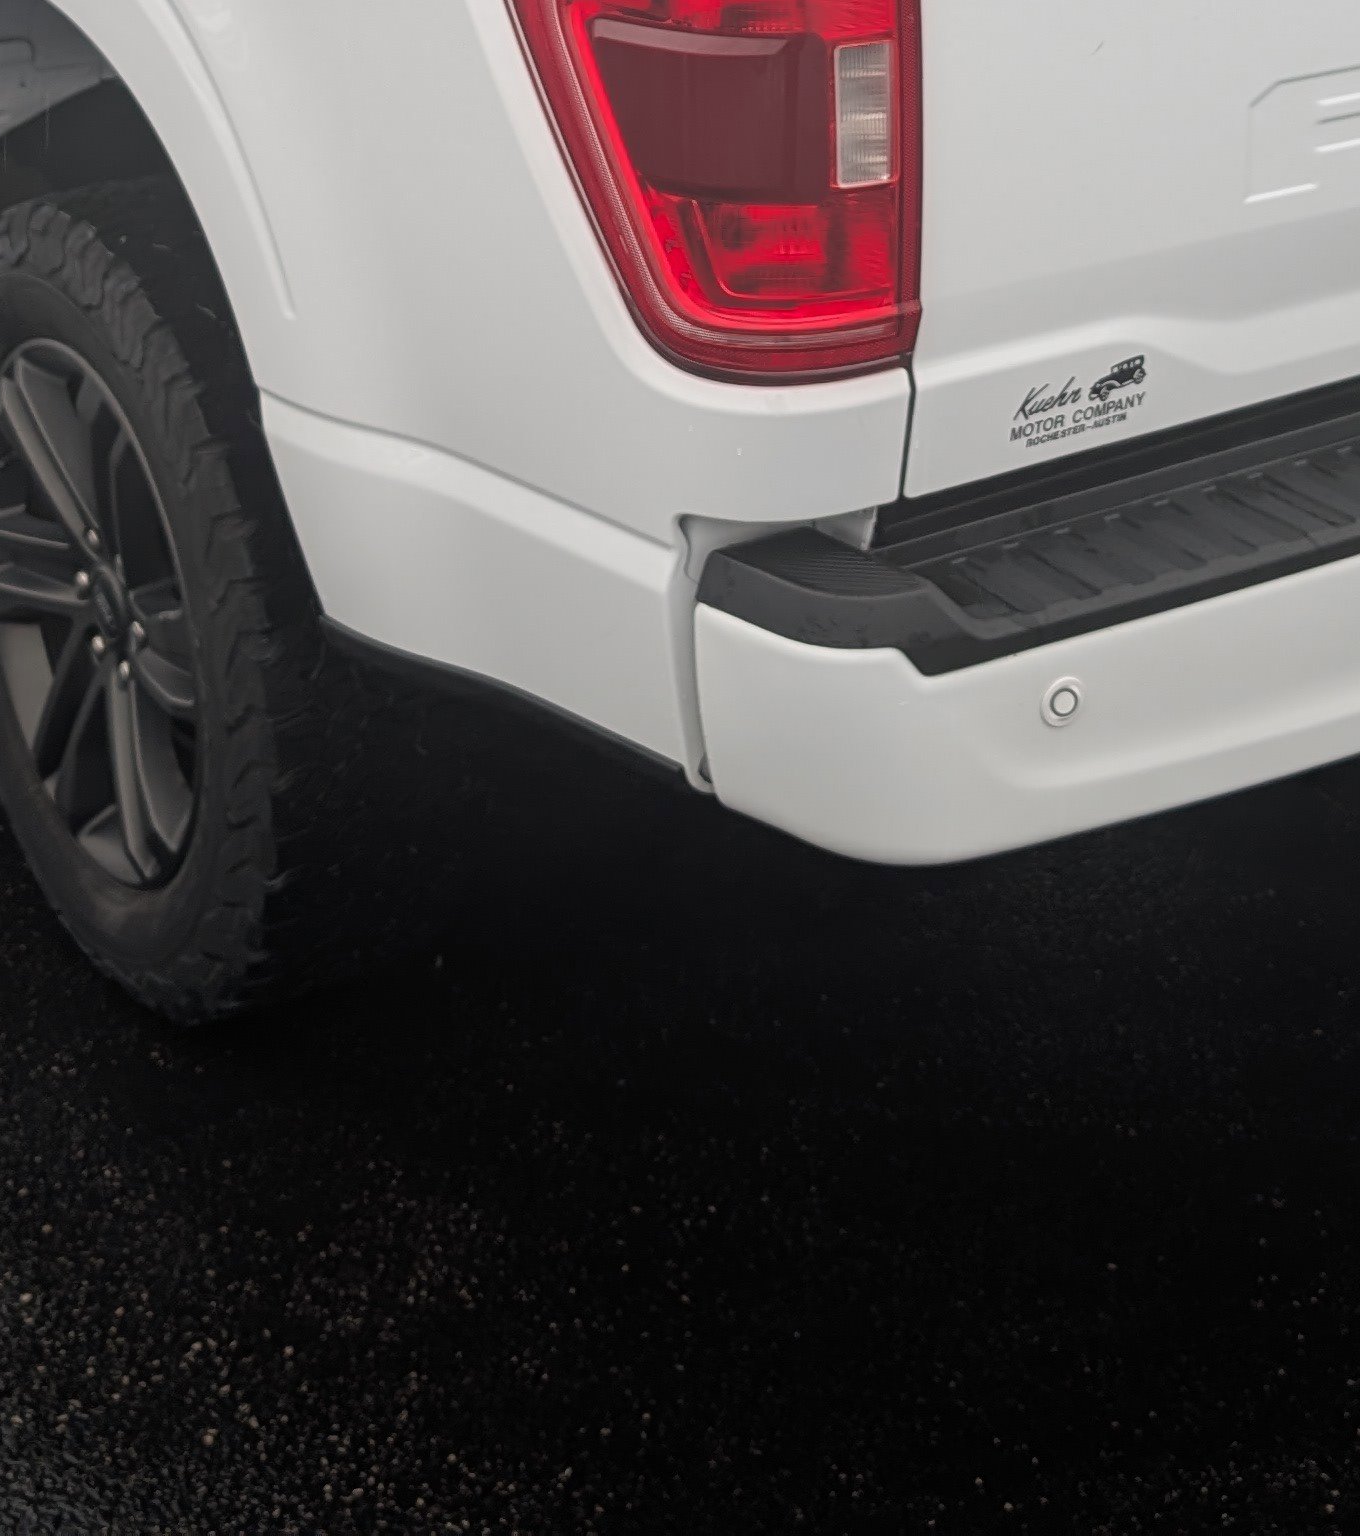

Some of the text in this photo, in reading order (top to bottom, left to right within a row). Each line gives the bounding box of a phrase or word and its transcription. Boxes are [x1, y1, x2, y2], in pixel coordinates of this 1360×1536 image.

[1009, 391, 1146, 442] MOTOR COMPANY
[1013, 376, 1082, 421] Kuehn
